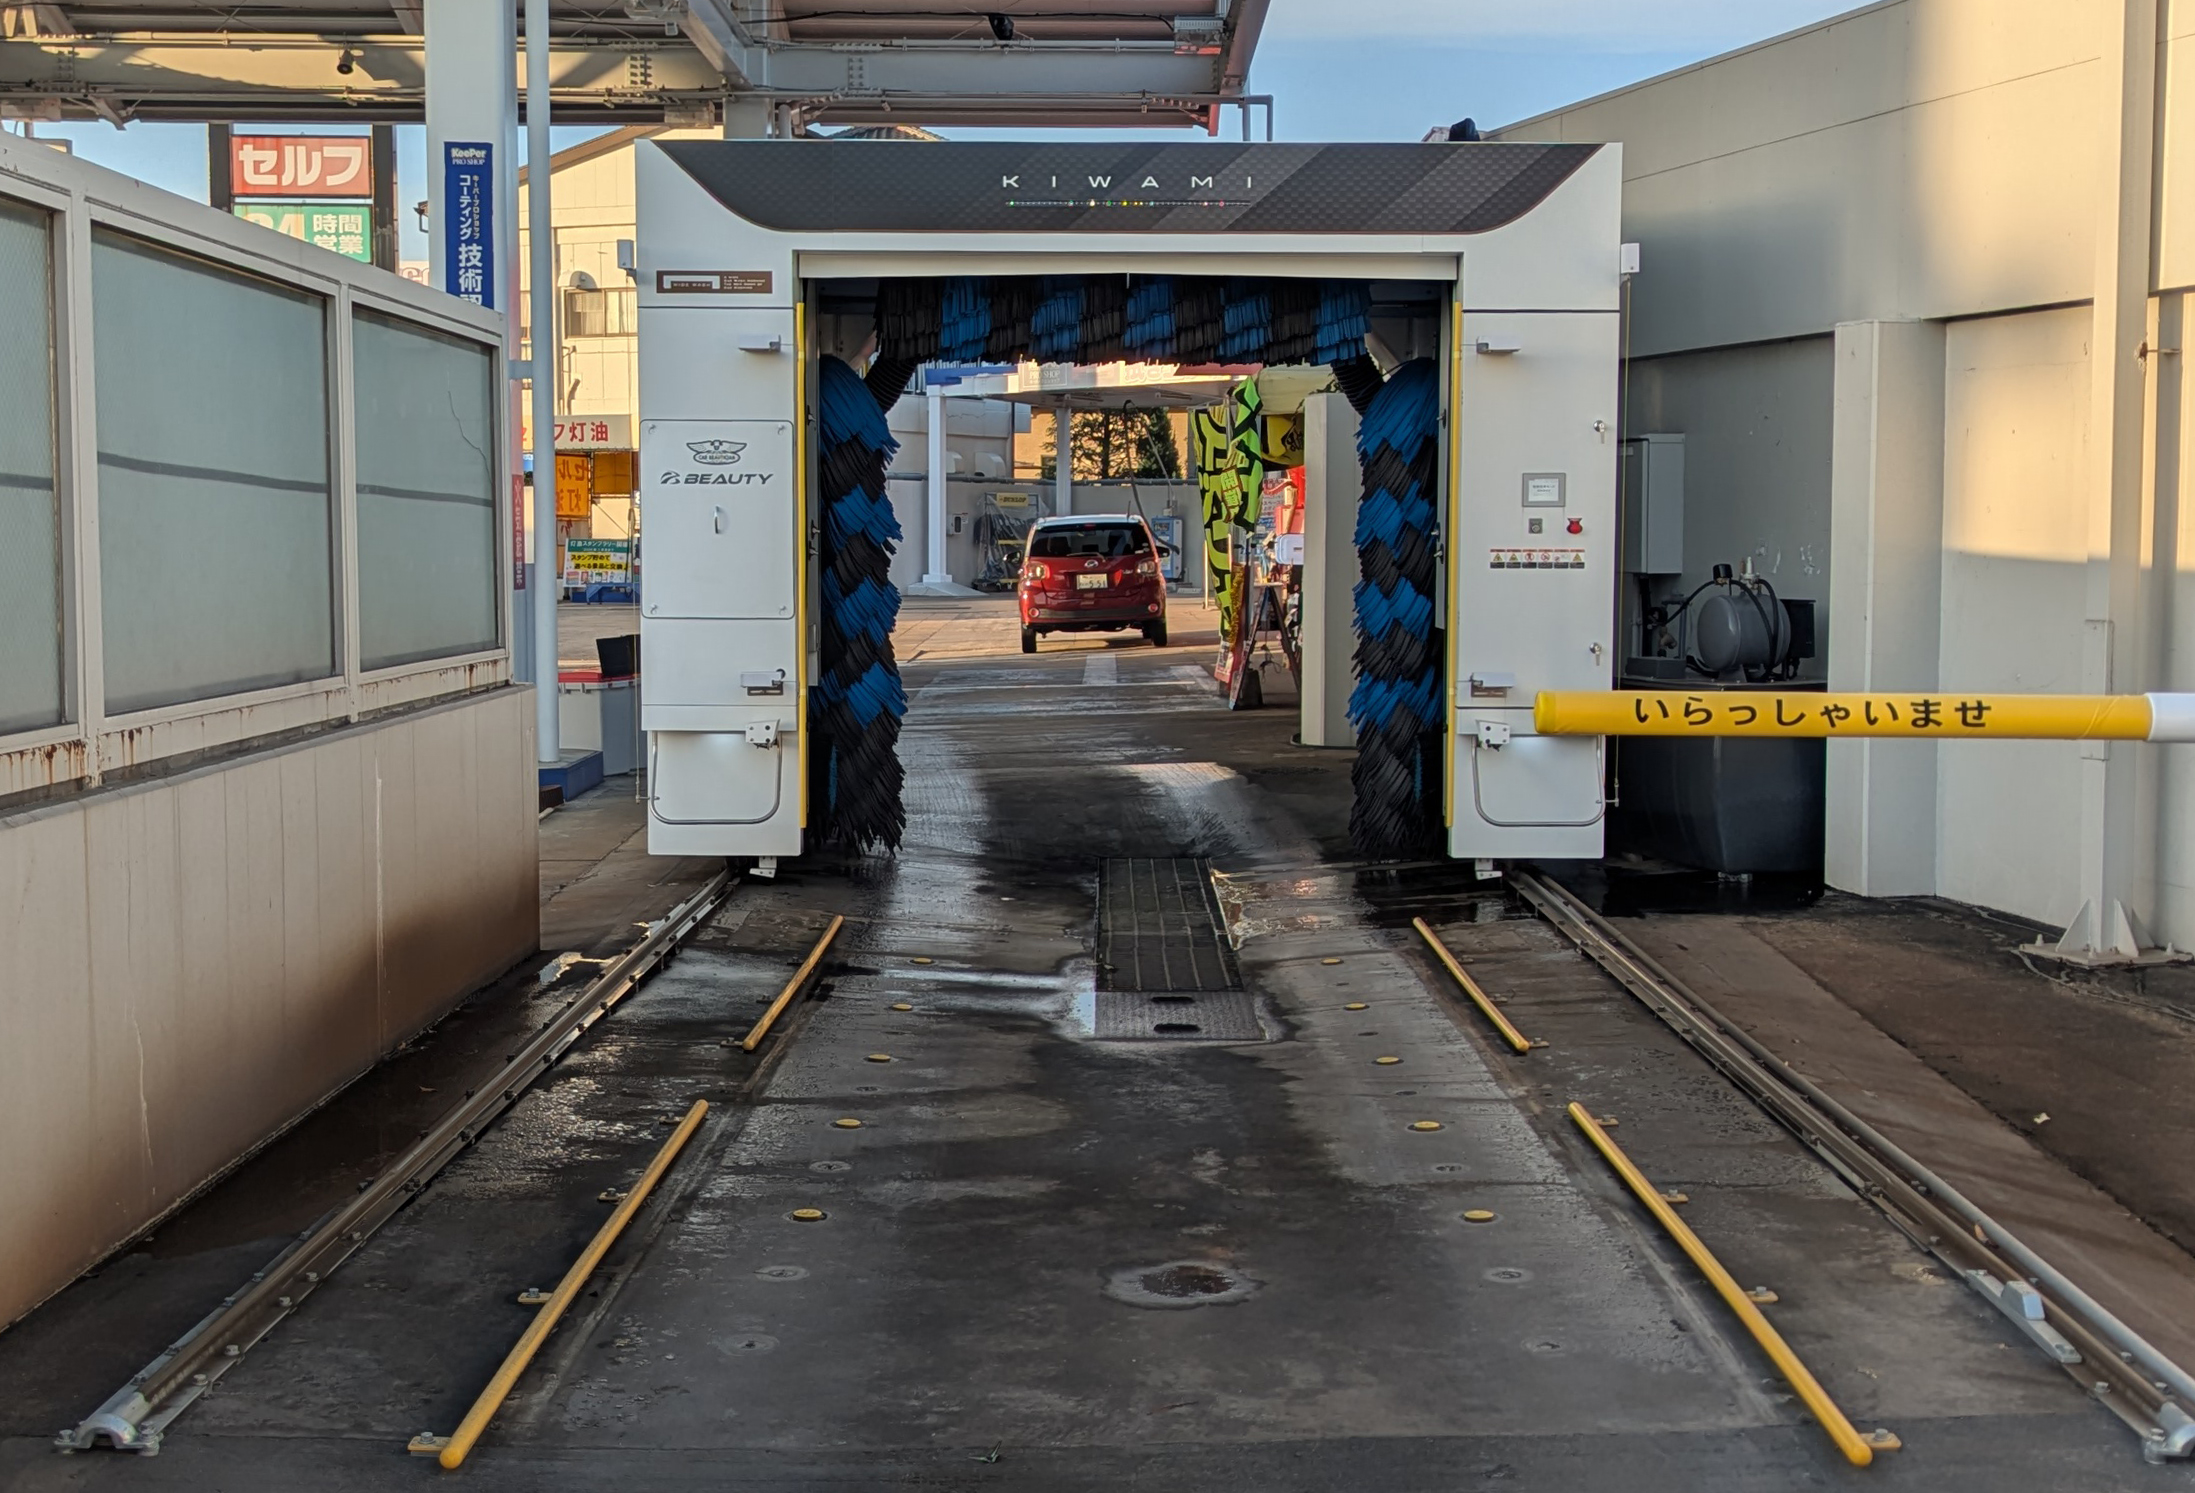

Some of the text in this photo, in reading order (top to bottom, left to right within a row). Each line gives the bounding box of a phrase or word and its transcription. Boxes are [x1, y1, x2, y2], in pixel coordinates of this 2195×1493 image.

[451, 148, 487, 158] KeePer
[467, 158, 485, 166] SHOP
[238, 144, 363, 187] セルフ
[1002, 175, 1252, 188] KIWAMI
[459, 174, 472, 241] コーティング
[312, 214, 362, 234] 時間
[313, 234, 363, 254] 営業
[683, 473, 774, 485] BEAUTY
[1635, 697, 1992, 729] いらっしゃいませ
